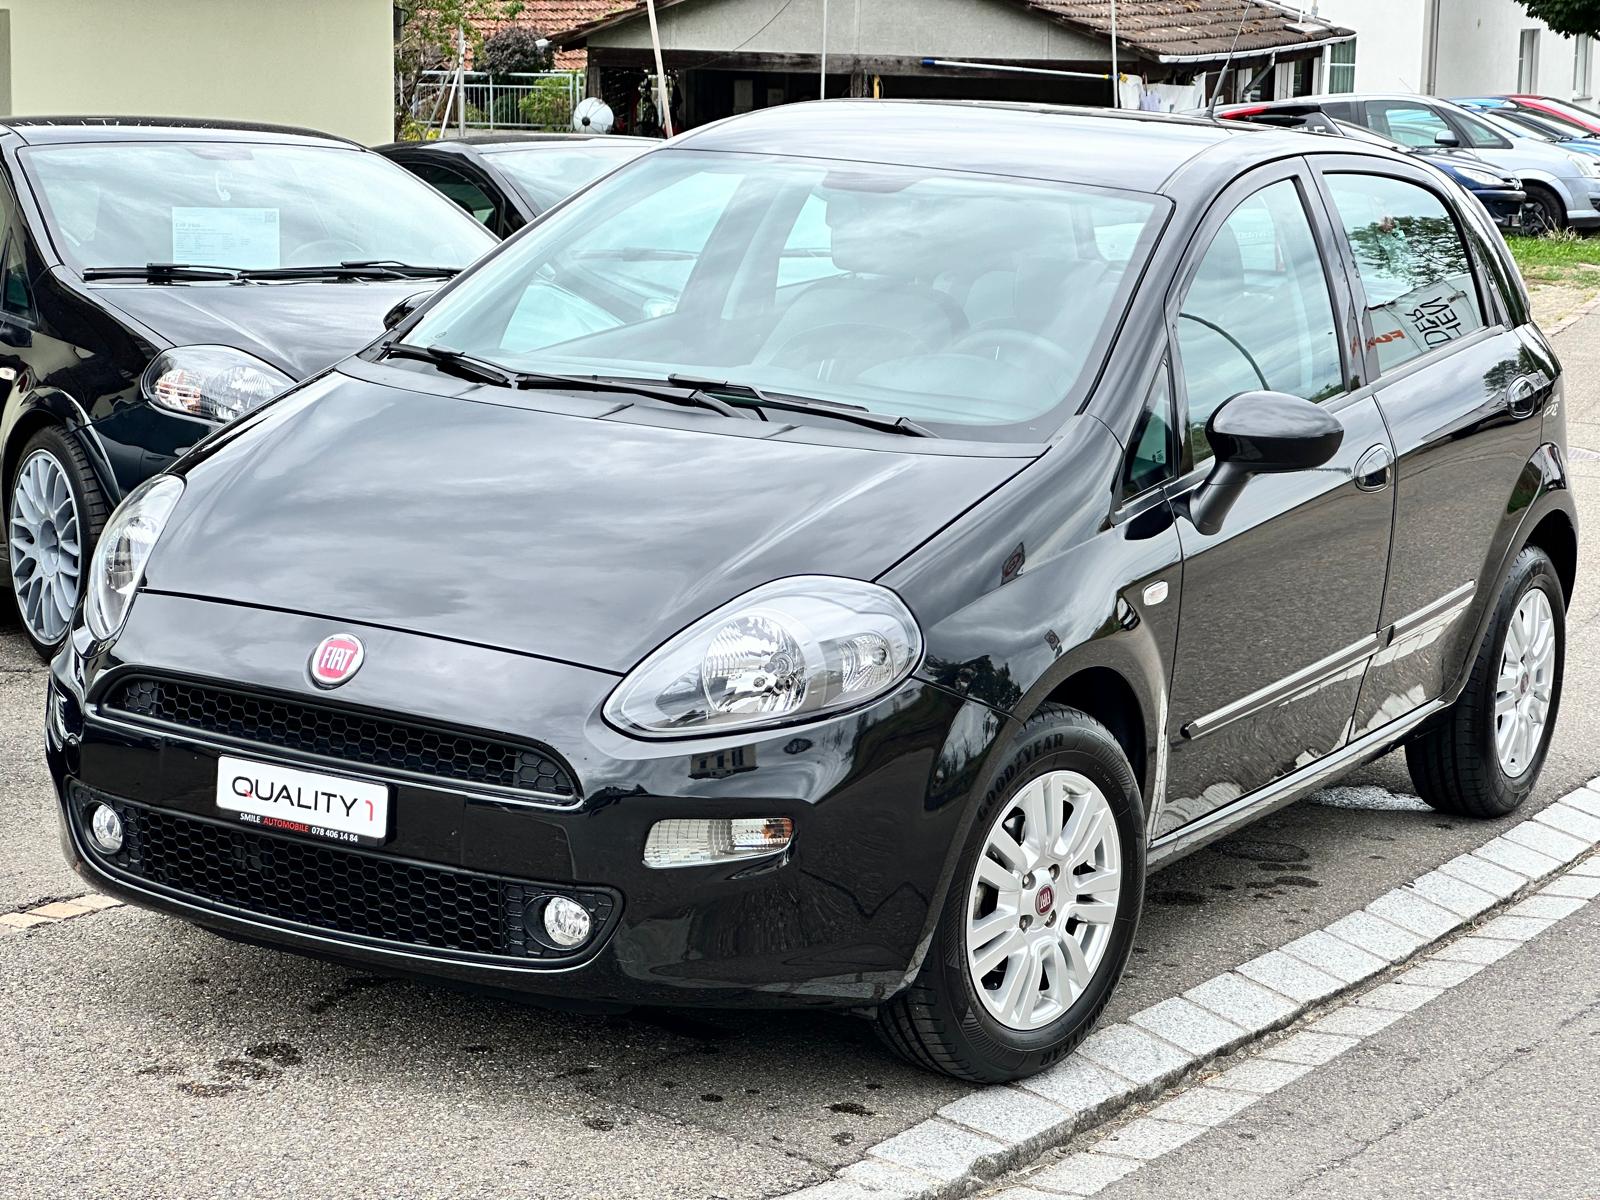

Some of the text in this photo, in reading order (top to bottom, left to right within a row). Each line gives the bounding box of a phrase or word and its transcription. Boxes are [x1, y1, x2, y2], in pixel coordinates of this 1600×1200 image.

[320, 646, 354, 671] FIAT
[976, 732, 1064, 823] GOODYEAR
[231, 775, 374, 822] QUALITY 1
[239, 812, 359, 843] SMILE AUTOMOBILE 078 406 14 84
